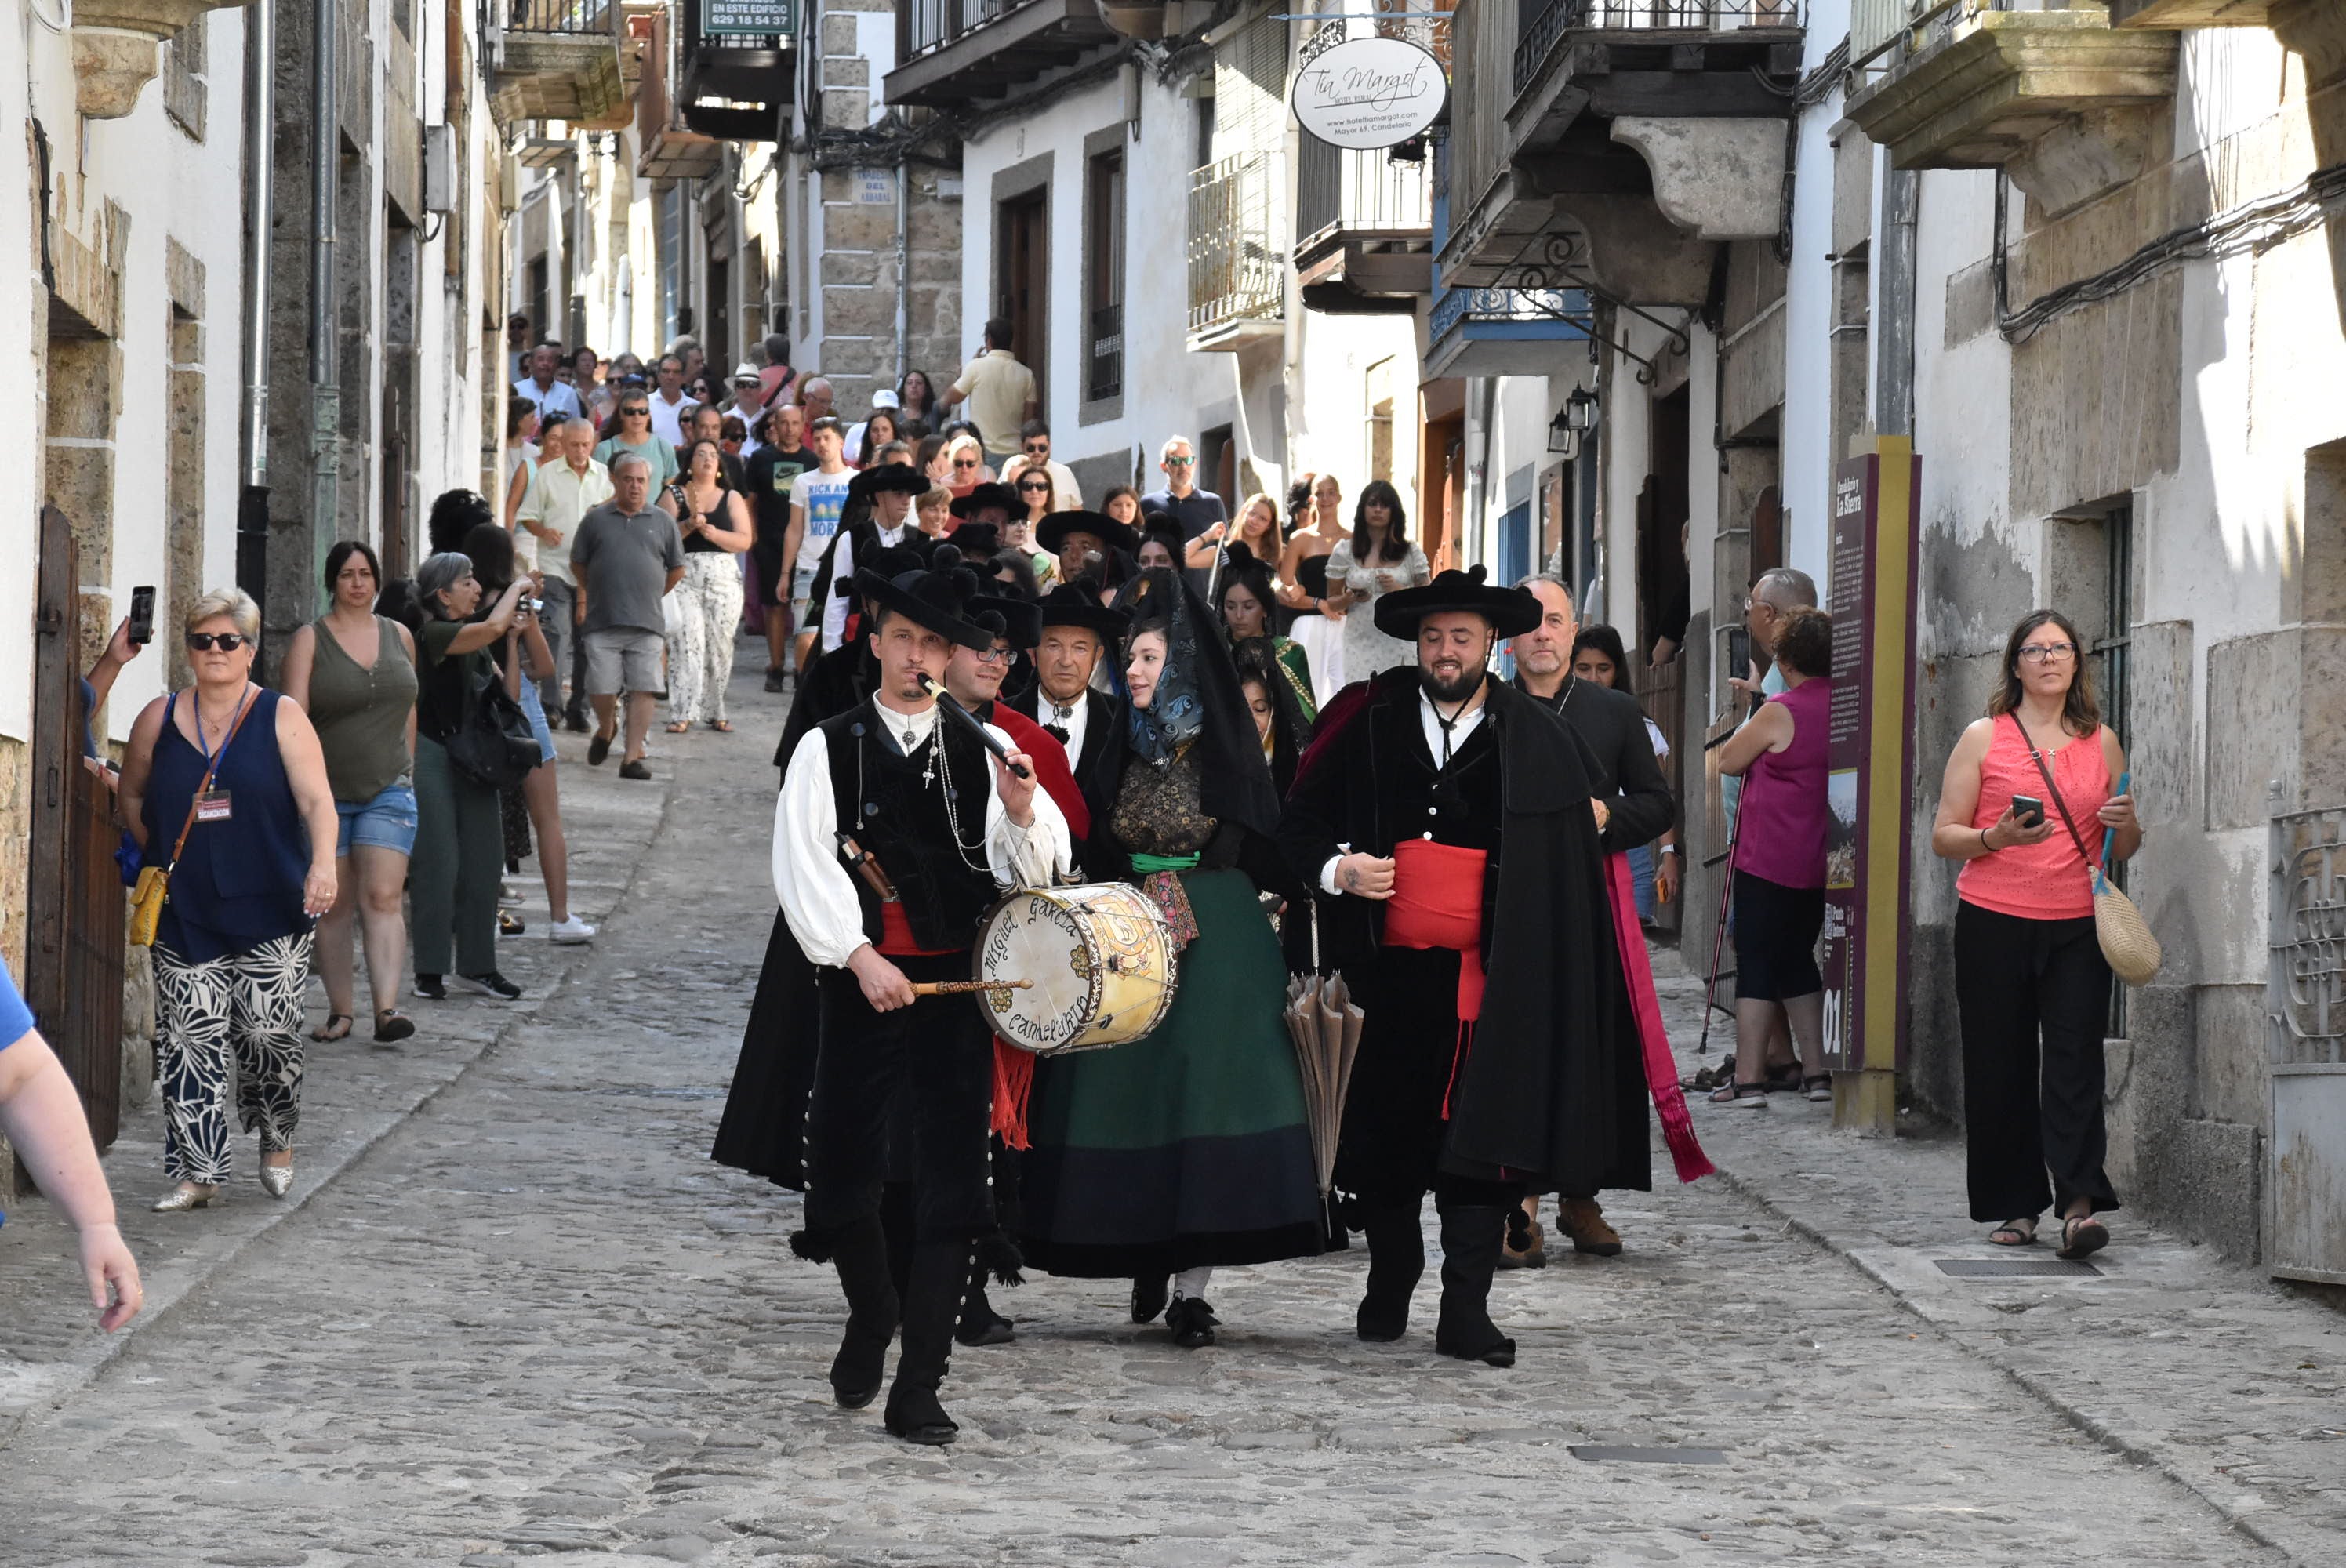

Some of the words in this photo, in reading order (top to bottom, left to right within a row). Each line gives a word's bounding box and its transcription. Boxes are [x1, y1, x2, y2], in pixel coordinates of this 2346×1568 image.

[712, 4, 724, 13] EN
[726, 4, 748, 13] ESTE
[750, 5, 787, 14] EDIFICIO
[712, 15, 734, 24] 629
[738, 16, 752, 25] 18
[754, 16, 769, 25] 54
[772, 16, 787, 25] 37
[1342, 56, 1428, 112] Margot
[1327, 112, 1418, 126] www.hoteltiamargot.com
[1371, 121, 1412, 132] Candelario
[808, 483, 830, 495] RICK
[1836, 495, 1844, 517] La
[1844, 492, 1861, 515] Sierra
[1822, 988, 1841, 1054] 01
